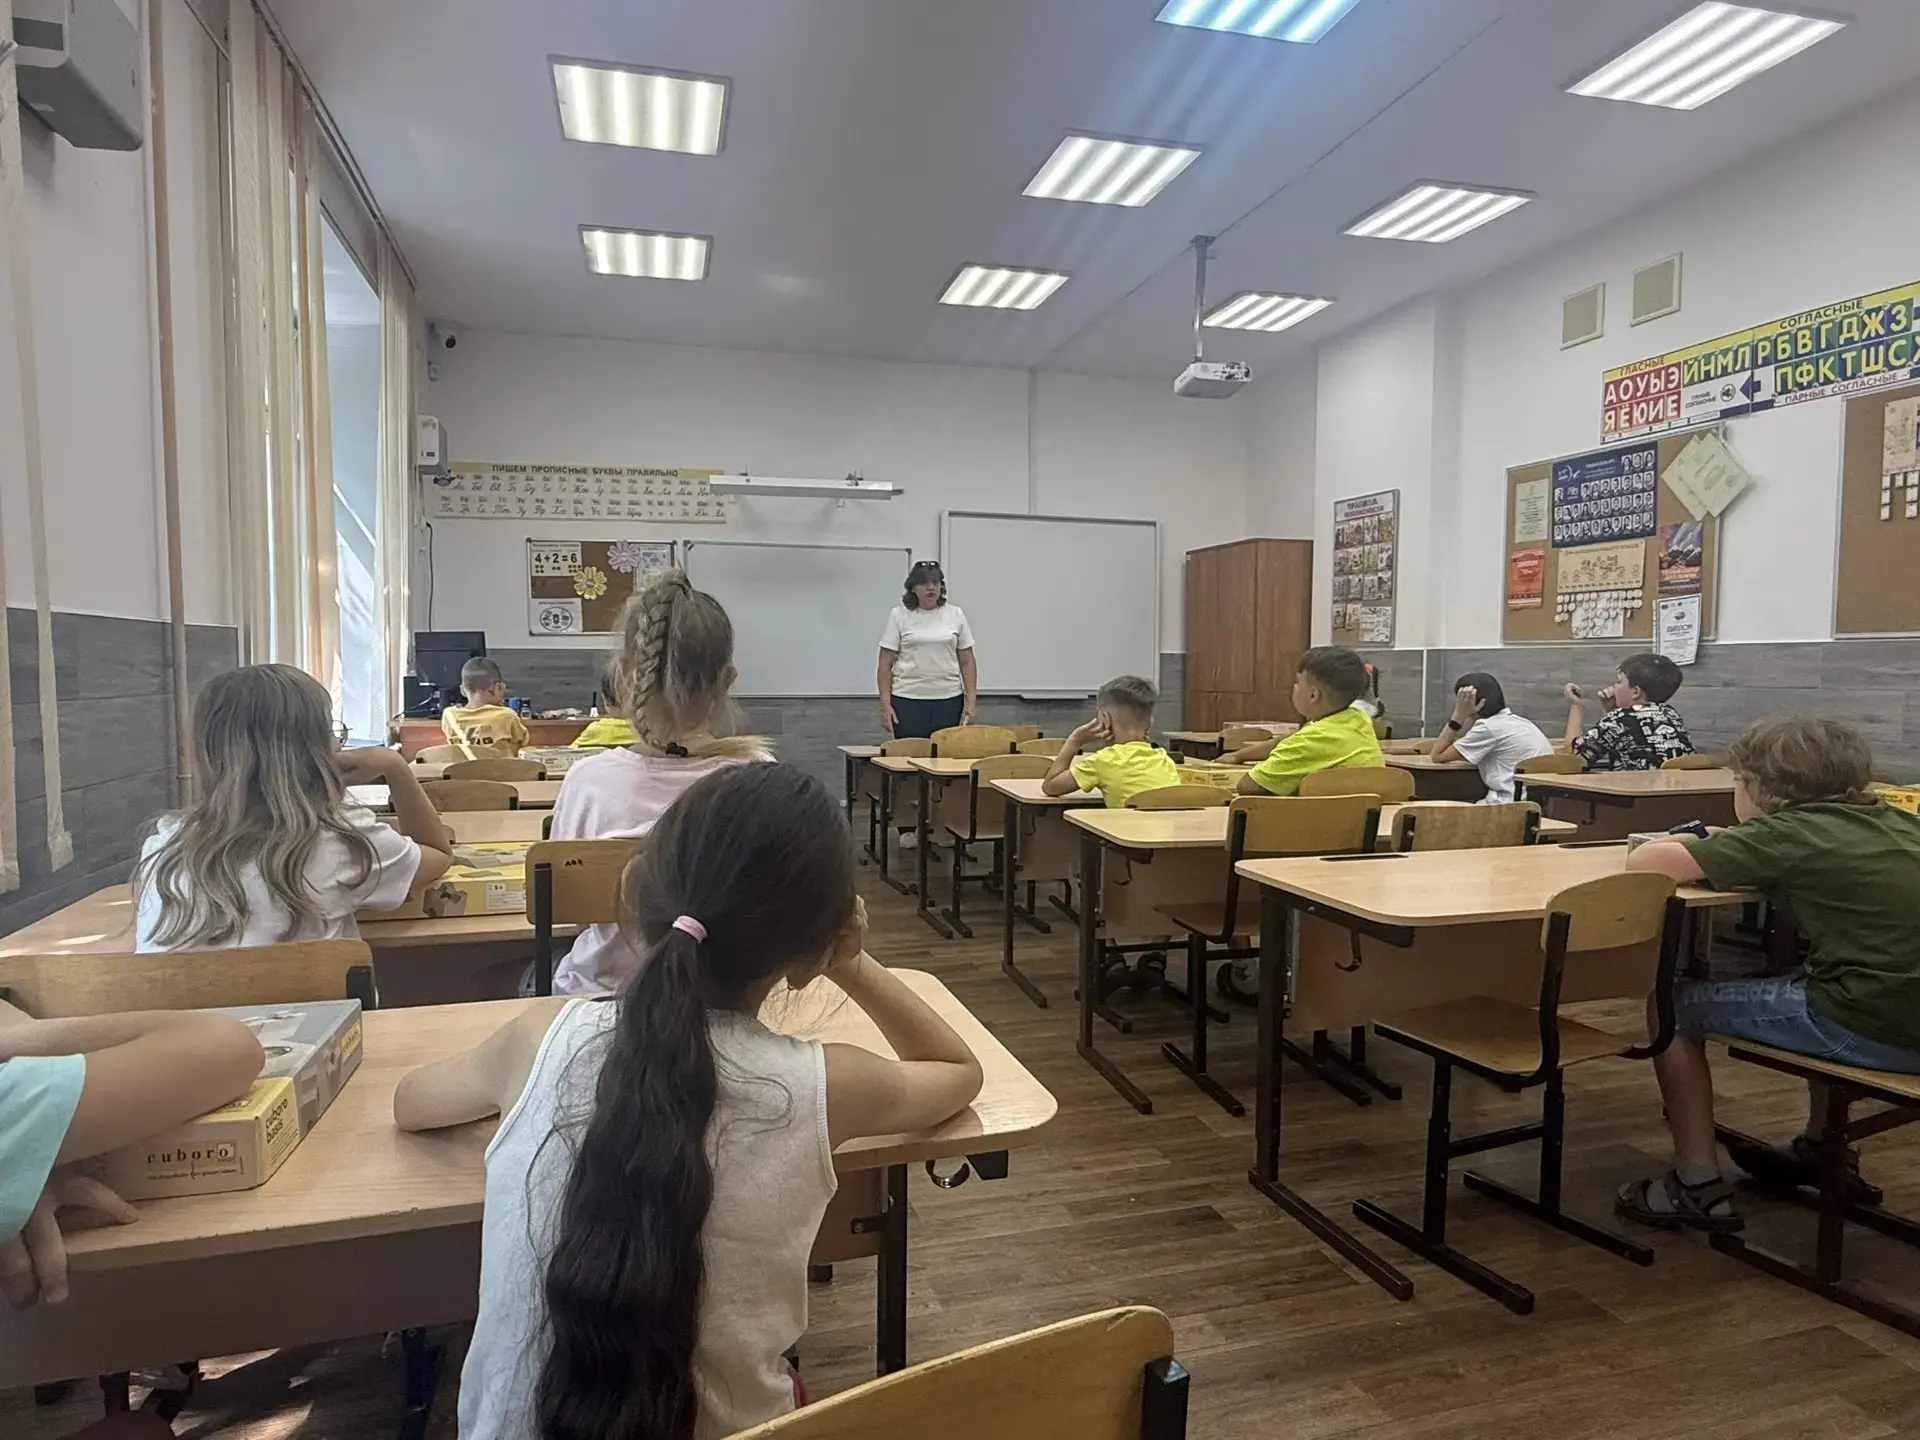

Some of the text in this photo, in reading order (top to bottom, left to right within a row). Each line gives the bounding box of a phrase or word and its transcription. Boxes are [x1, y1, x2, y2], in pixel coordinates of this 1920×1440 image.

[1780, 299, 1864, 330] СОГЛАСНЫЕ
[1619, 356, 1665, 376] ГЛАСНЫЕ
[1784, 372, 1898, 404] ПАРНЫЕ СОГЛАСНЫЕ
[492, 465, 527, 473] ПИШЕМ
[531, 466, 588, 475] ПРОПИСНЫЕ
[626, 468, 679, 477] ПРАВИЛЬНО
[265, 1098, 288, 1129] cuboro
[266, 1118, 284, 1145] basis
[147, 1147, 229, 1164] cuboro
